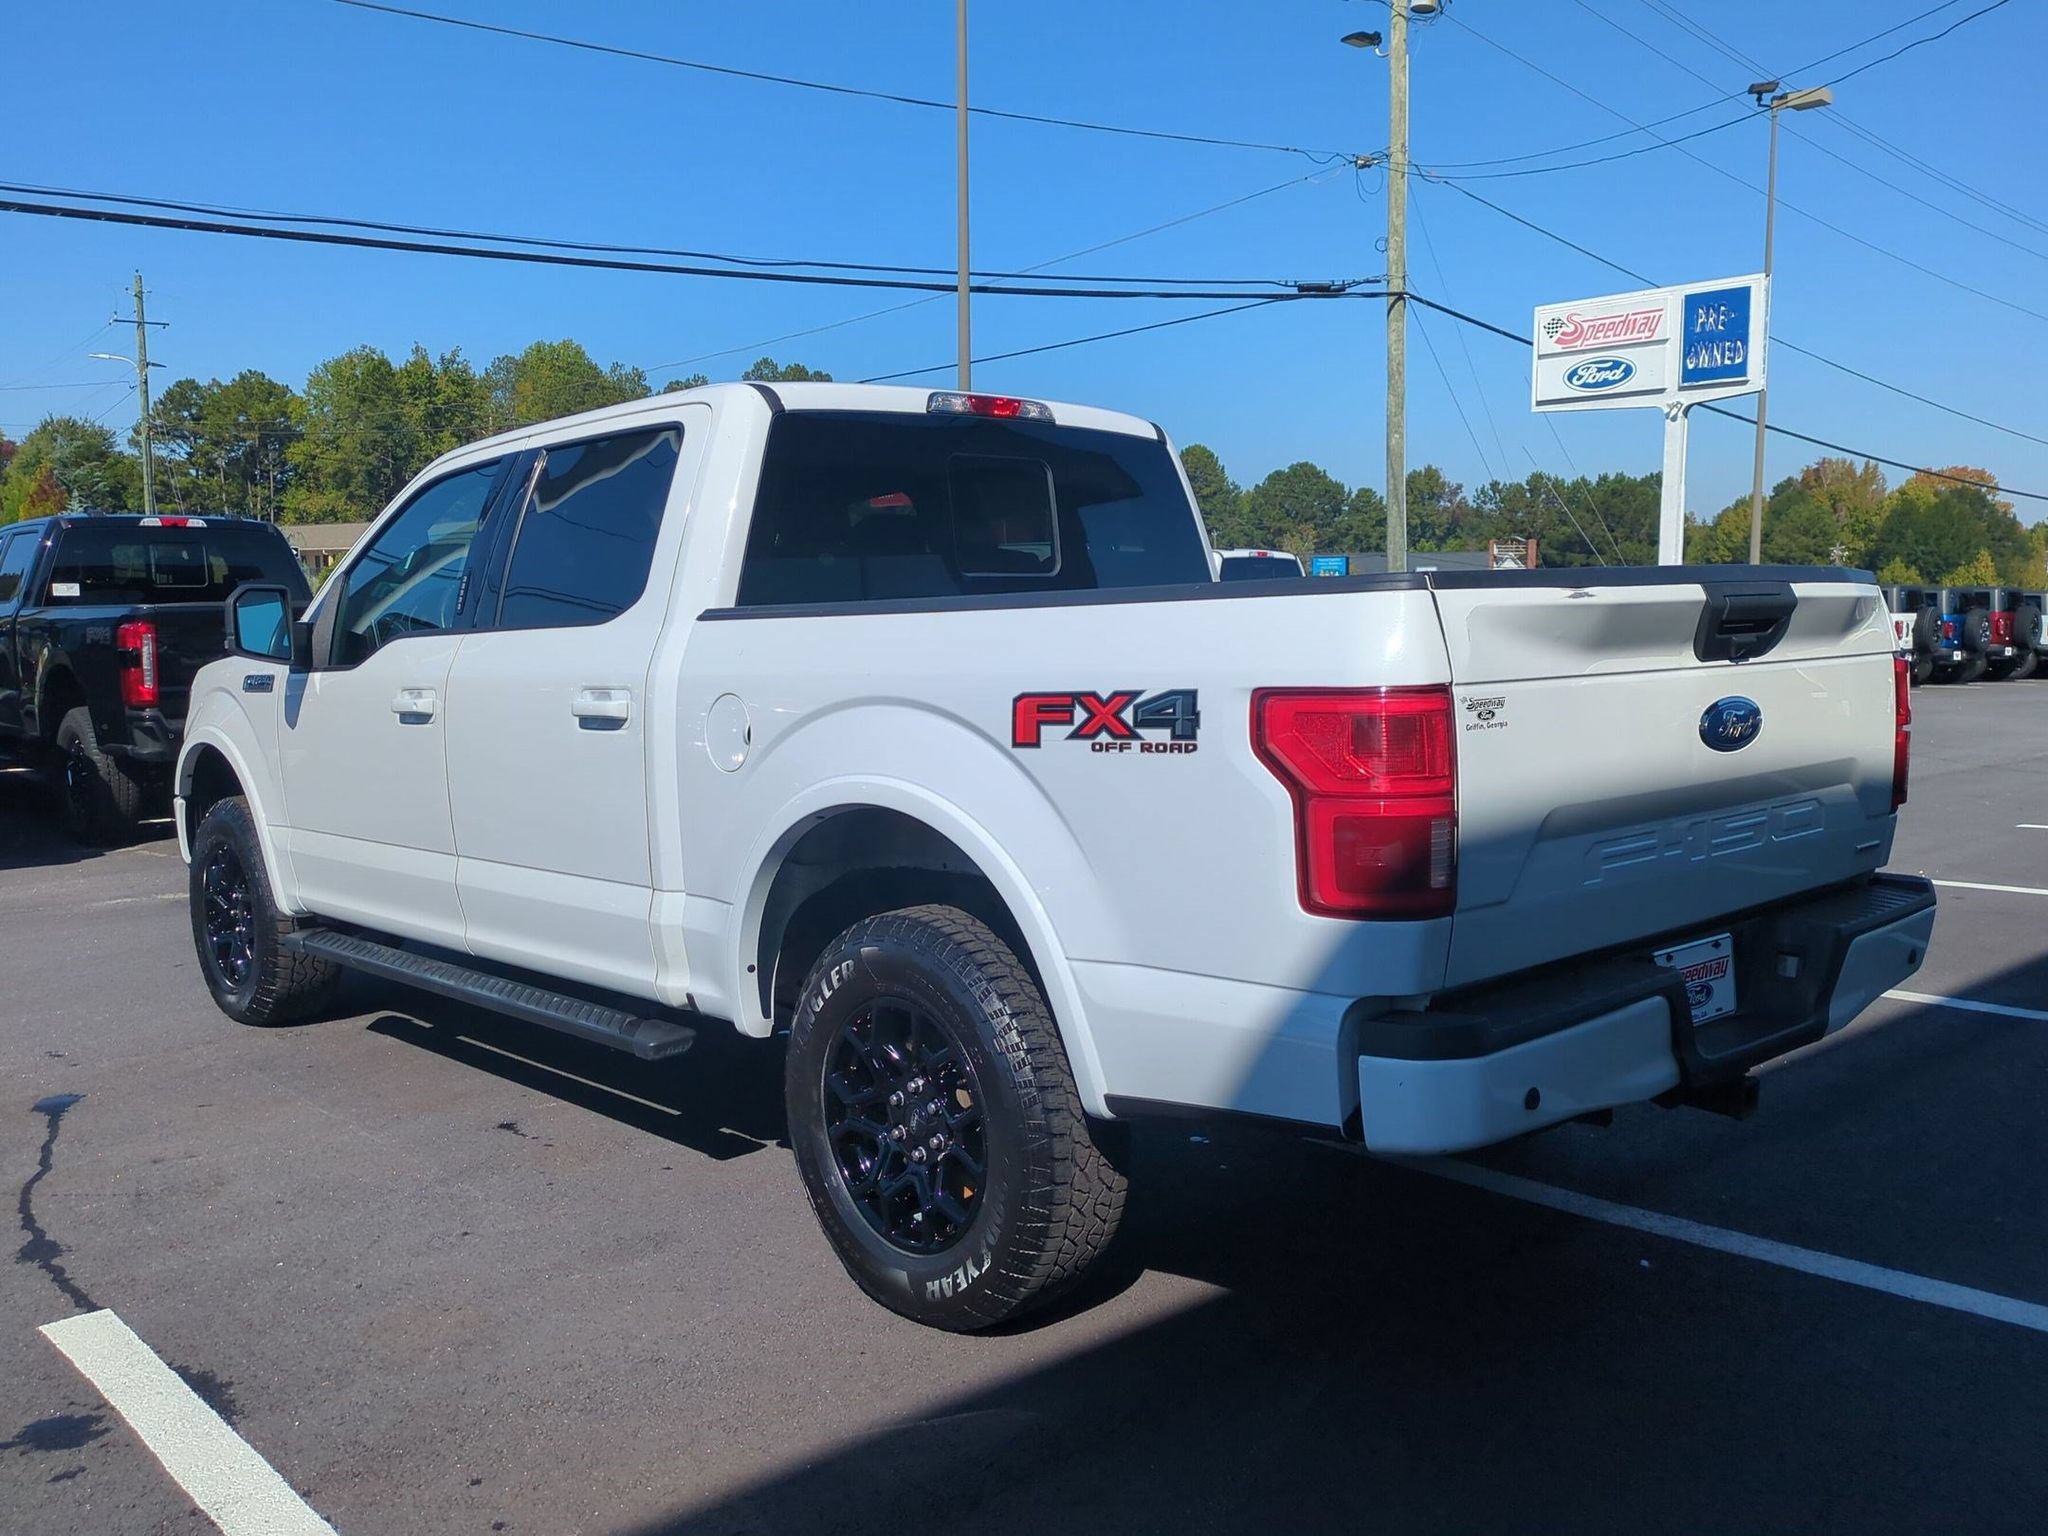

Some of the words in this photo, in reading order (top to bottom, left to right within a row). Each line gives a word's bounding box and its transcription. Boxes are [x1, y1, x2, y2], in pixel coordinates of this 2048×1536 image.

[1554, 311, 1664, 347] Speedway
[1570, 361, 1625, 386] Ford
[1465, 697, 1506, 711] Speedway
[1011, 688, 1200, 749] FX4
[1718, 709, 1753, 738] Ford
[1091, 741, 1132, 753] OFF
[1140, 741, 1198, 754] ROAD
[1683, 958, 1729, 982] eedway
